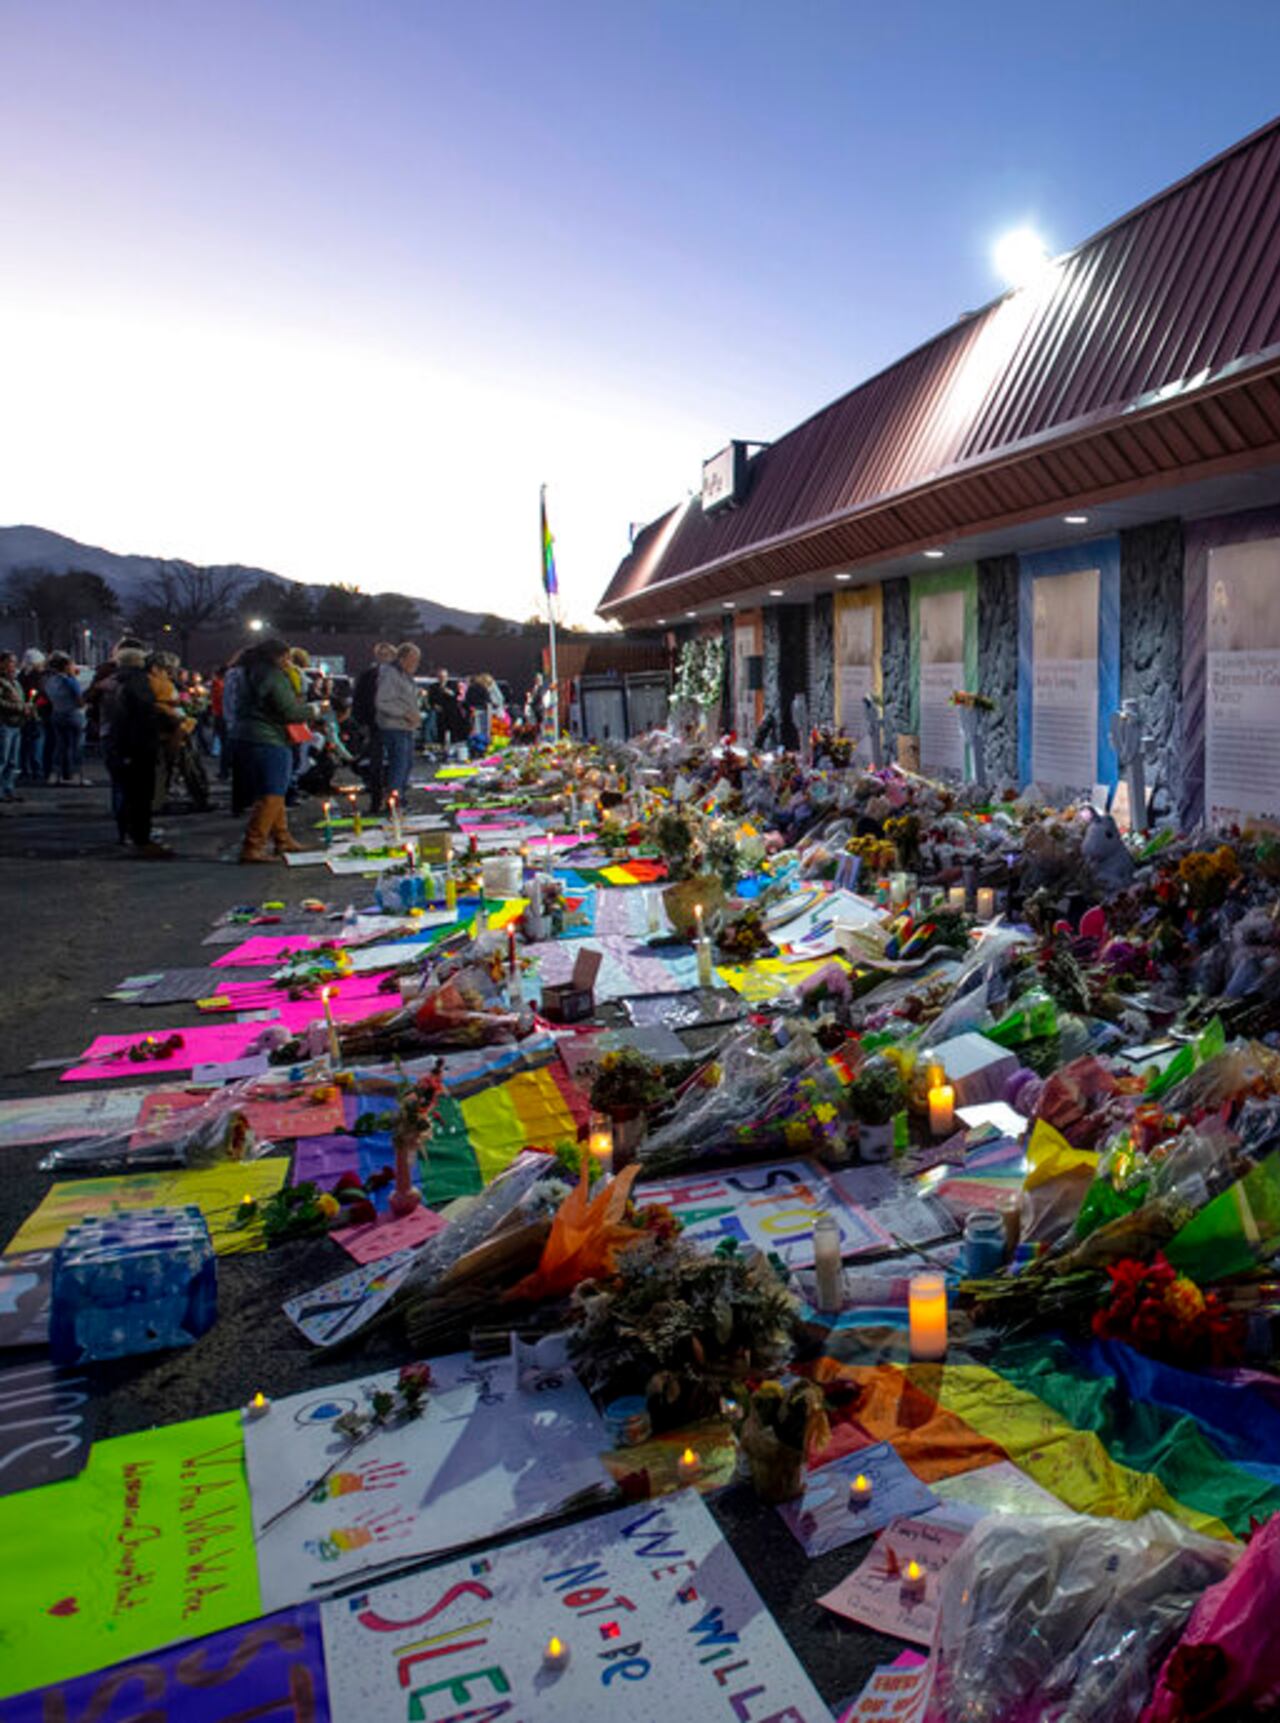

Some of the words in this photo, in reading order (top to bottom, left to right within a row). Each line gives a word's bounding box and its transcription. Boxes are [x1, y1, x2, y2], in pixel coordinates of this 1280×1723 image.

[637, 1180, 750, 1242] HAT
[543, 1560, 638, 1618] NOT
[619, 1507, 698, 1581] WE
[688, 1605, 767, 1722] WILL
